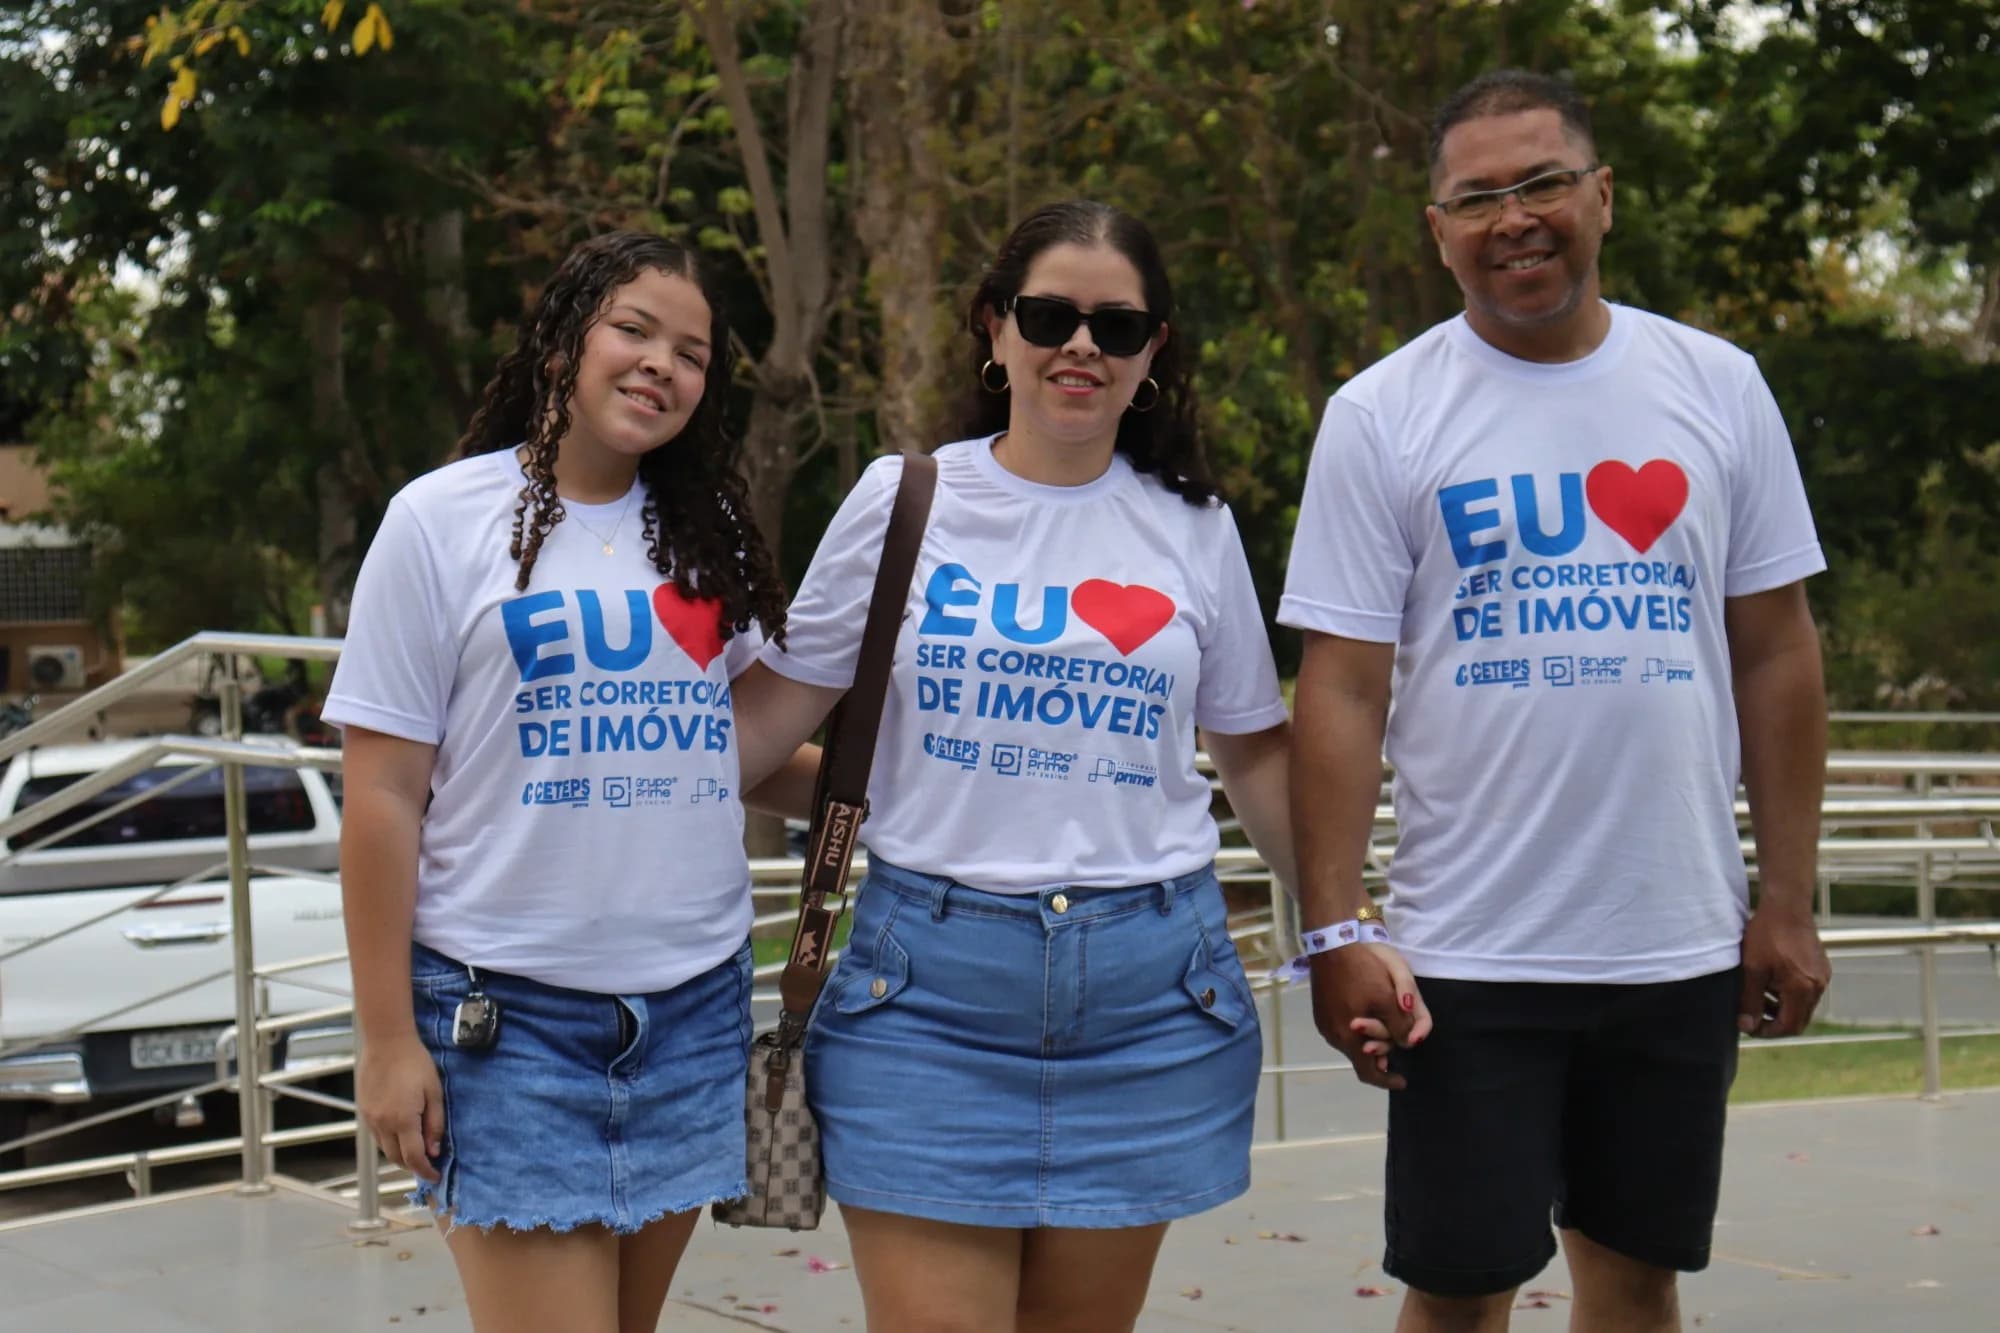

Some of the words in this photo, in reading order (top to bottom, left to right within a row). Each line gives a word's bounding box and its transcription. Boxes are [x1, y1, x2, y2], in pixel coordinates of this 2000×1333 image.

[1438, 472, 1586, 569] EU
[1455, 569, 1503, 600] SER
[1511, 561, 1696, 591] CORRETOR(A)
[918, 562, 1068, 645] EU
[1453, 601, 1504, 642] DE
[1518, 588, 1692, 634] IMÓVEIS
[501, 589, 653, 683] EU
[916, 643, 967, 670] SER
[976, 647, 1175, 701] CORRETOR(A)
[1471, 658, 1530, 680] CETEPS
[516, 685, 572, 713] SER
[917, 675, 963, 715] DE
[976, 681, 1166, 741] IMÓVEIS
[518, 719, 571, 758] DE
[1028, 759, 1070, 773] Prime
[535, 778, 590, 800] CETEPS
[636, 788, 671, 798] Prime
